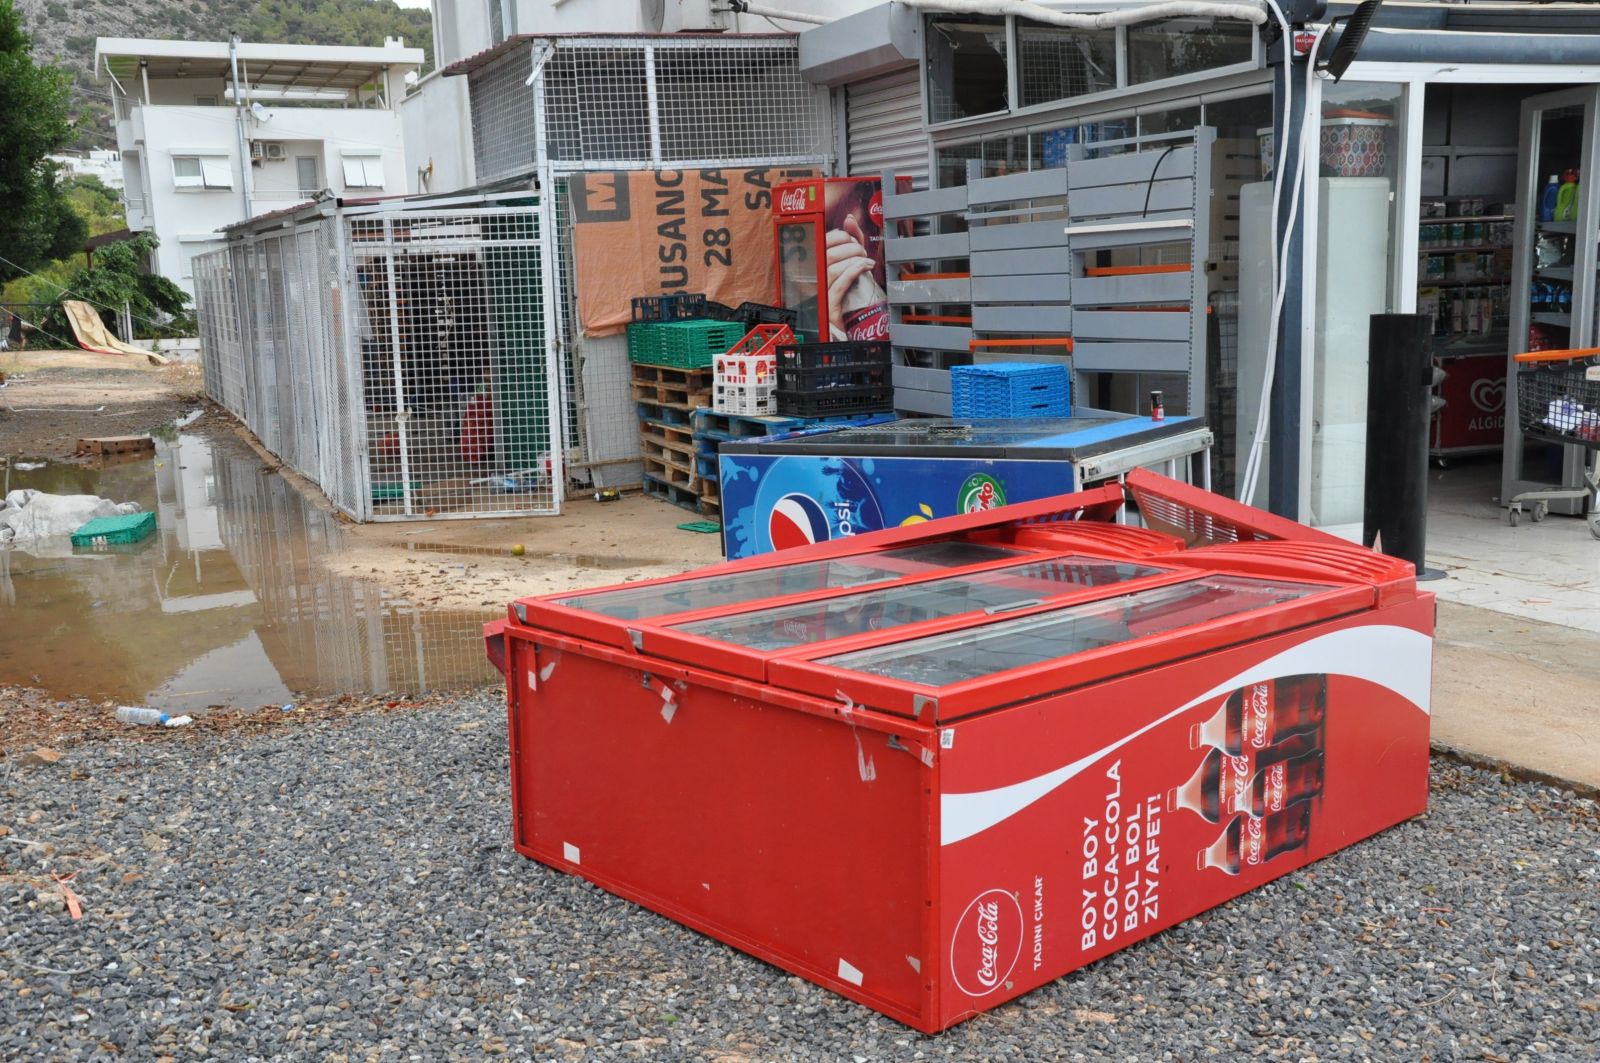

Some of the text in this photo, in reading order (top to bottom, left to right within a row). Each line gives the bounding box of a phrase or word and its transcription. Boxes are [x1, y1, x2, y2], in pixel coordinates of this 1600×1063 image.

[781, 187, 806, 212] Coca-Cola
[702, 227, 732, 267] 28
[1251, 684, 1268, 748] Coca-Cola
[1270, 765, 1283, 812] Coca-Cola
[1103, 759, 1121, 941] COCA-COLA
[1124, 803, 1141, 932] BOL BOL
[1081, 816, 1098, 951] BOY BOY
[977, 901, 998, 987] Coca-Cola
[1033, 924, 1042, 972] TADINI
